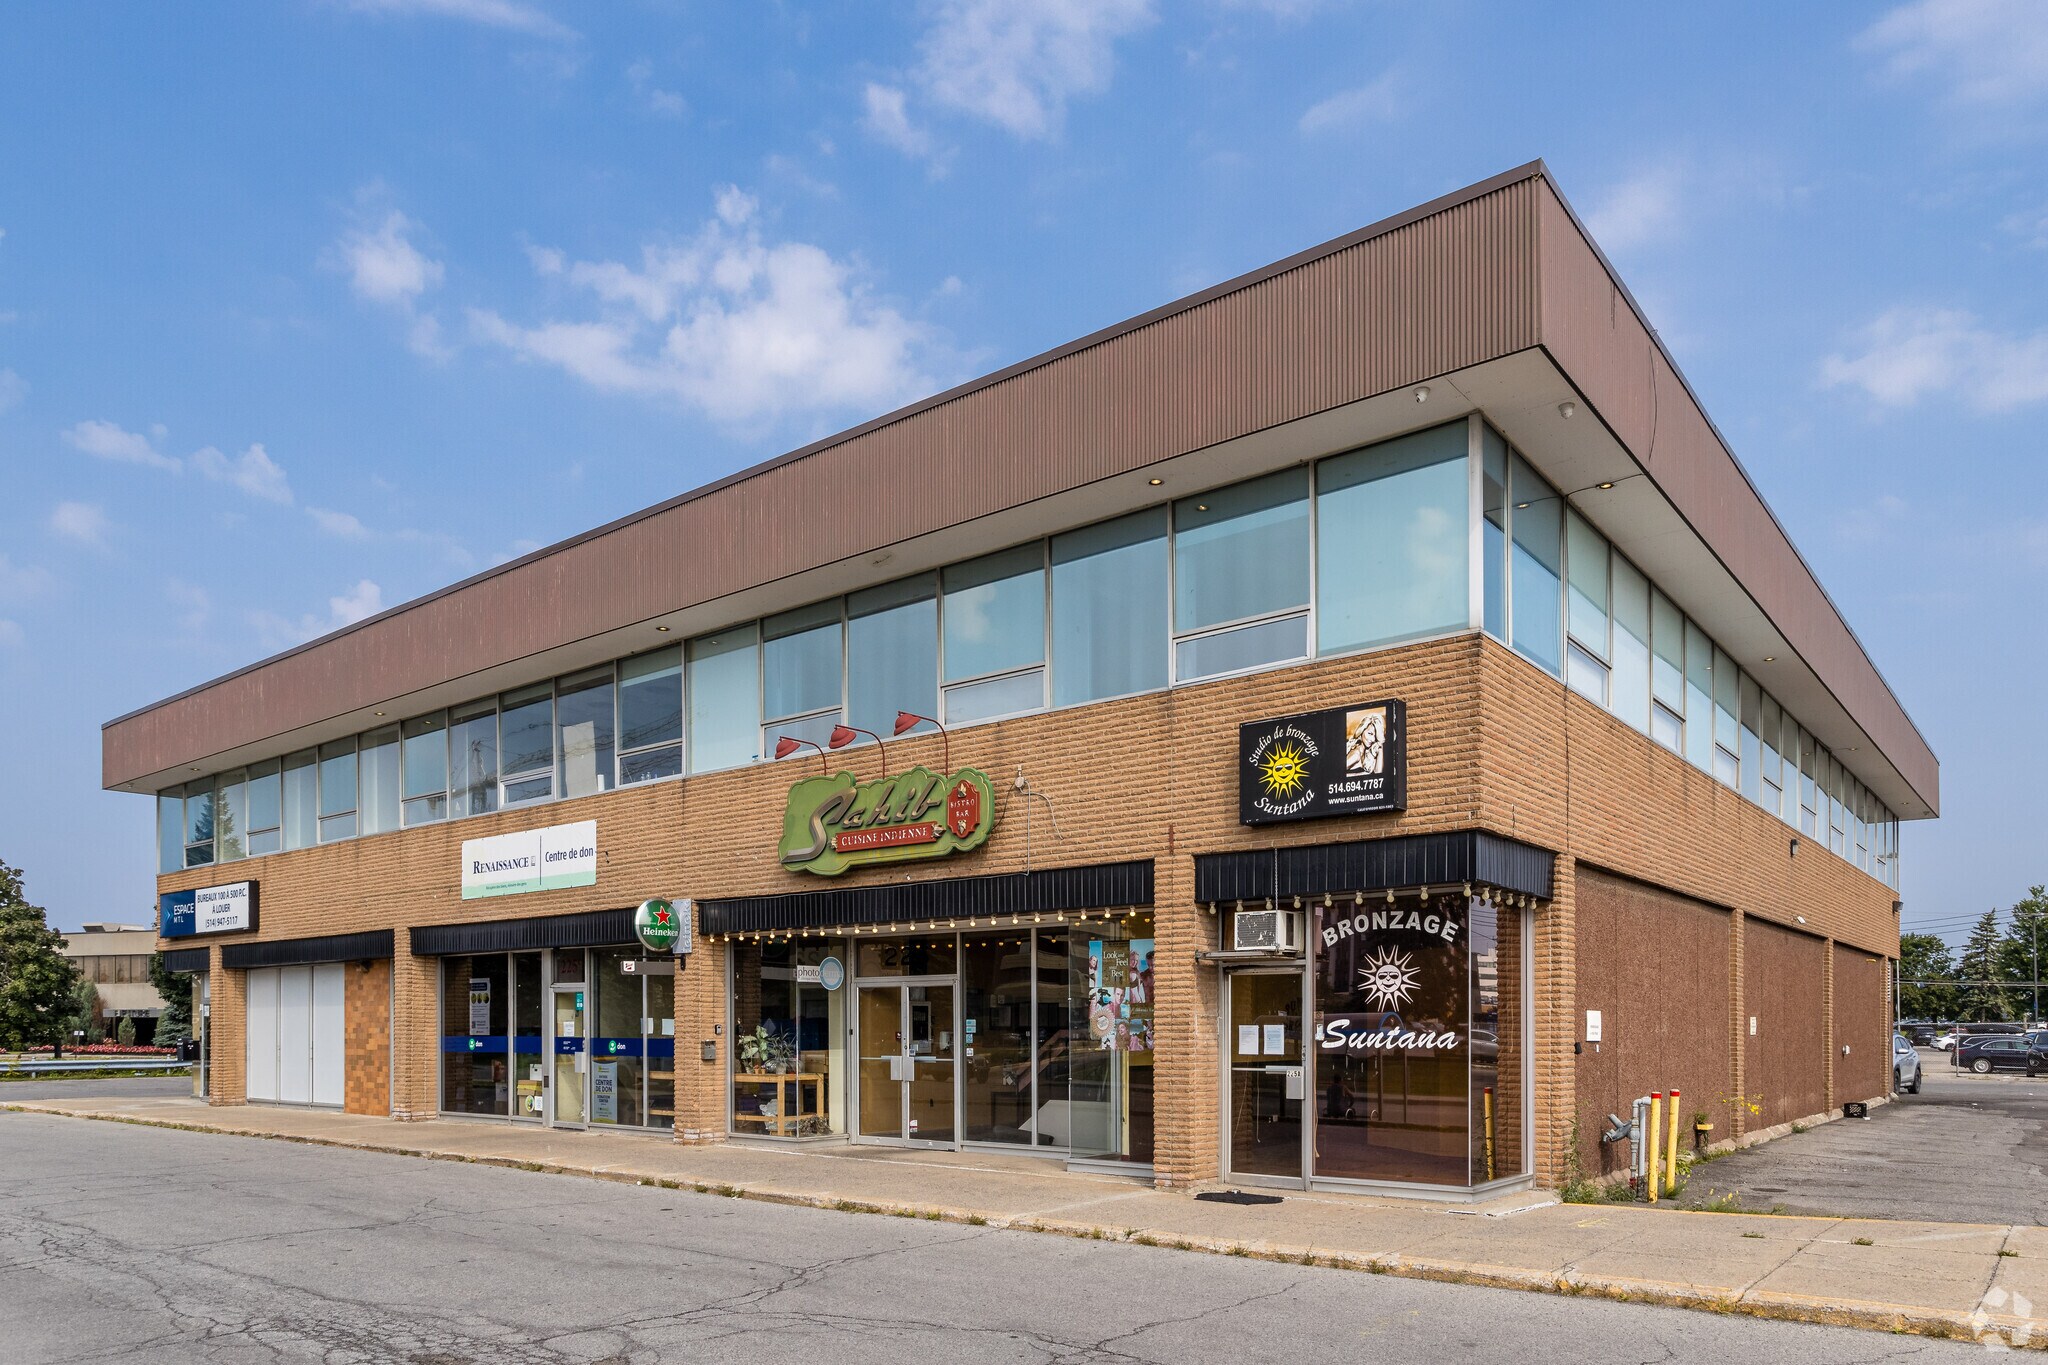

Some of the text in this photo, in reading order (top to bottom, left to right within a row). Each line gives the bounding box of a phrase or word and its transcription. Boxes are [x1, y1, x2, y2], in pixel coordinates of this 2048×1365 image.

[1249, 723, 1321, 767] Studio de bronzage
[1328, 777, 1384, 795] 514.694.7787
[950, 798, 975, 808] BISTRO
[1254, 789, 1316, 816] Suntana
[1328, 792, 1384, 805] www.suntana.ca
[781, 777, 942, 865] Sahib
[955, 810, 969, 818] BAR
[841, 827, 928, 847] CUISINE INDIENNE
[545, 851, 567, 863] Centre
[568, 848, 578, 860] de
[579, 846, 594, 858] don
[473, 857, 530, 874] RENAISSANCE
[197, 892, 218, 903] BUREAUX
[174, 903, 195, 915] ESPACE
[212, 903, 231, 914] À LOUER
[173, 915, 184, 924] MTL
[642, 926, 679, 937] Heineken
[1322, 910, 1459, 948] BRONZAGE
[1103, 950, 1118, 959] Look
[1321, 1018, 1459, 1050] Suntana
